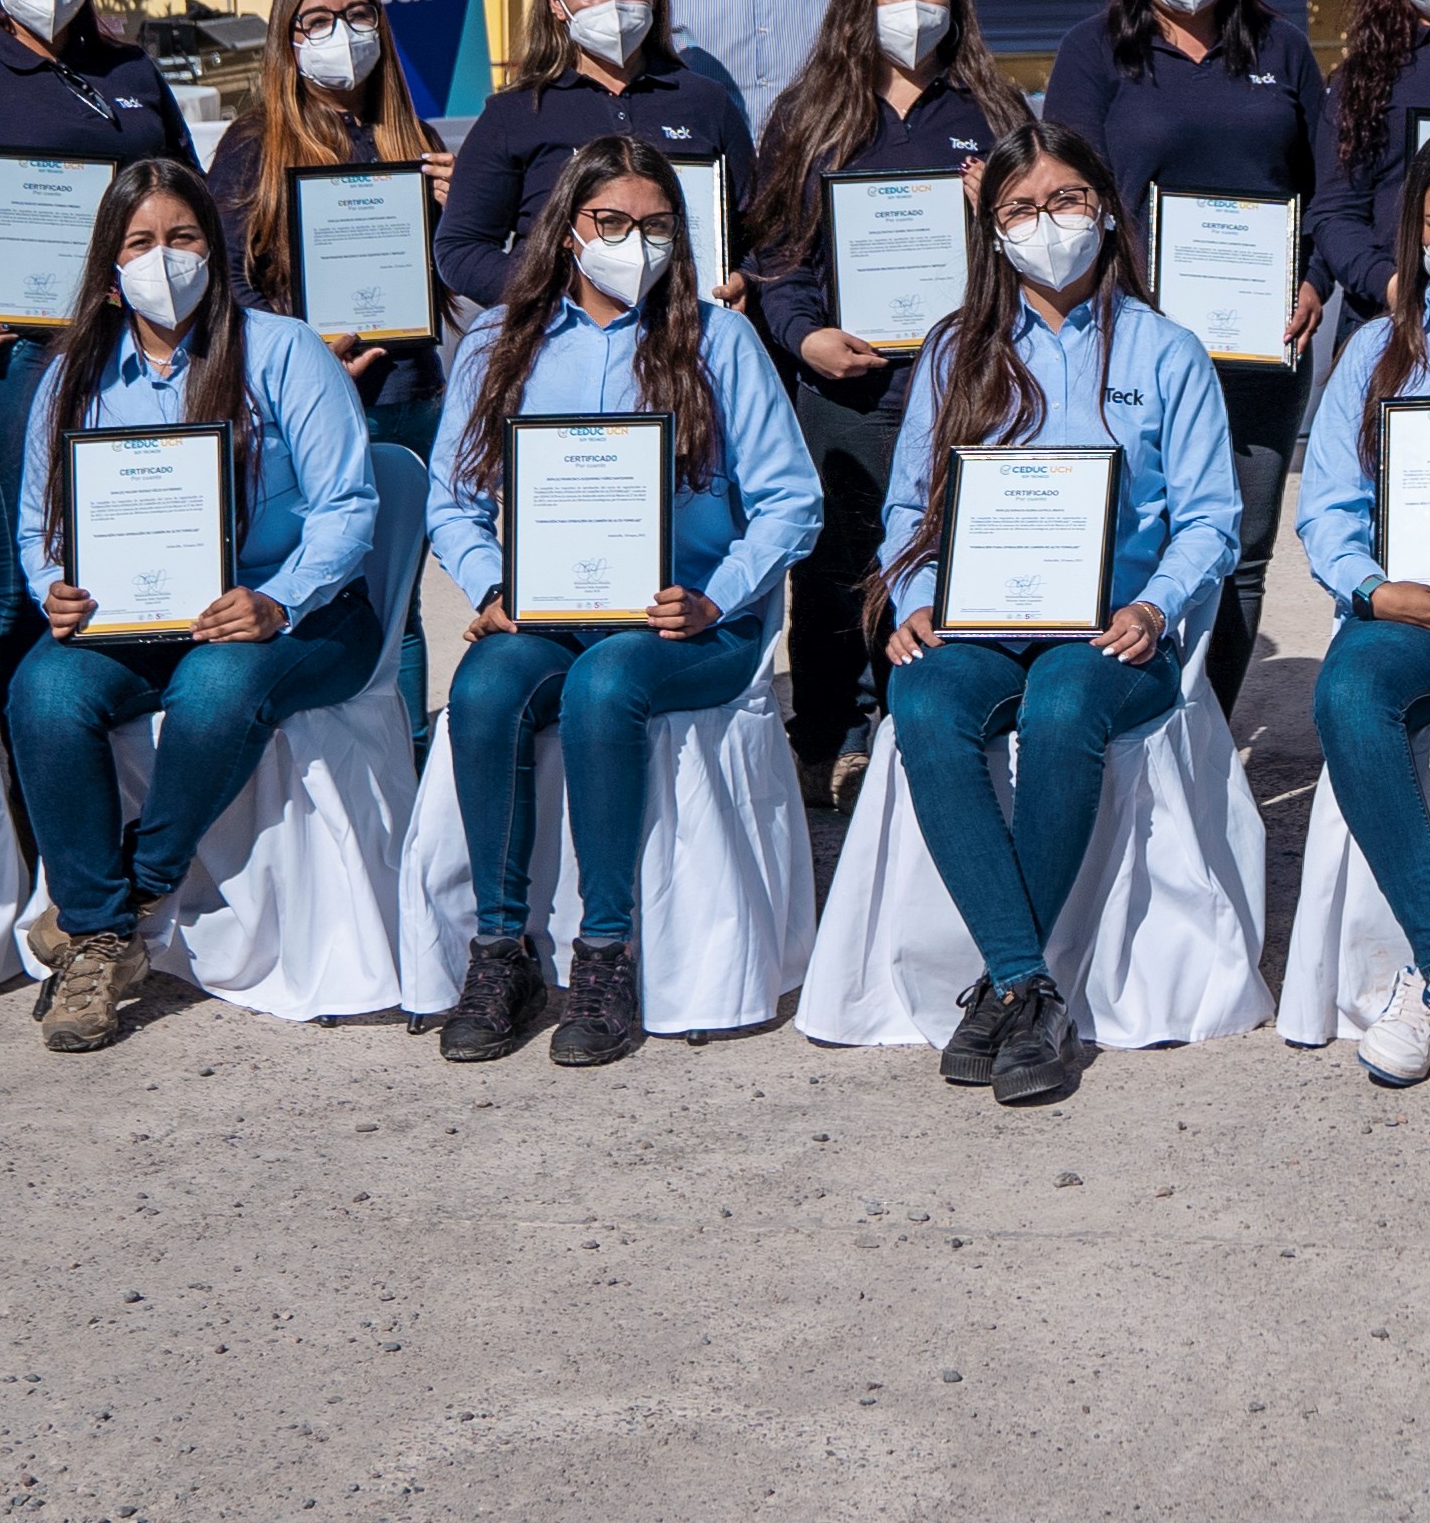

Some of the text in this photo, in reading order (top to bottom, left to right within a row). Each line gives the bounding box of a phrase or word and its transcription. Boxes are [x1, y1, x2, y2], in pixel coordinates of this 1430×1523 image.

[661, 126, 693, 139] Teck
[949, 137, 979, 152] Teck
[23, 183, 72, 192] CERTIFICADO
[878, 186, 909, 194] CEDUC
[875, 209, 923, 218] CERTIFICADO
[1202, 222, 1248, 231] CERTIFICADO
[1105, 387, 1145, 406] Teck
[564, 455, 617, 463] CERTIFICADO
[120, 466, 173, 476] CERTIFICADO
[1012, 466, 1048, 474] CEDUC
